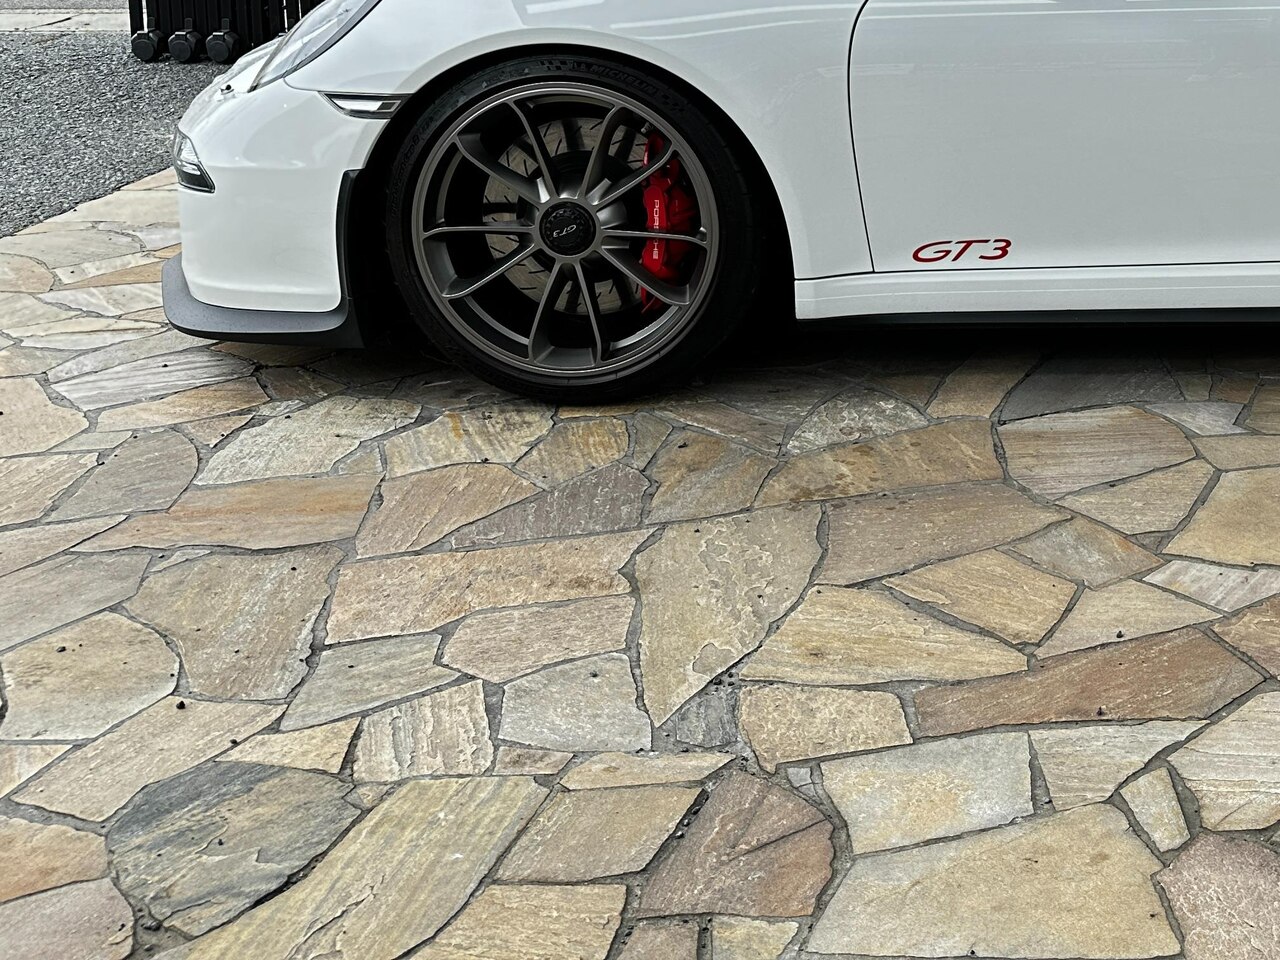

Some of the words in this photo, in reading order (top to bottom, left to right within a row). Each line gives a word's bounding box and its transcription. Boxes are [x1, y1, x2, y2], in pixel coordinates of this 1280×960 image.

[590, 63, 661, 98] MICHELIN
[553, 224, 577, 238] GT3
[912, 238, 1012, 263] GT3
